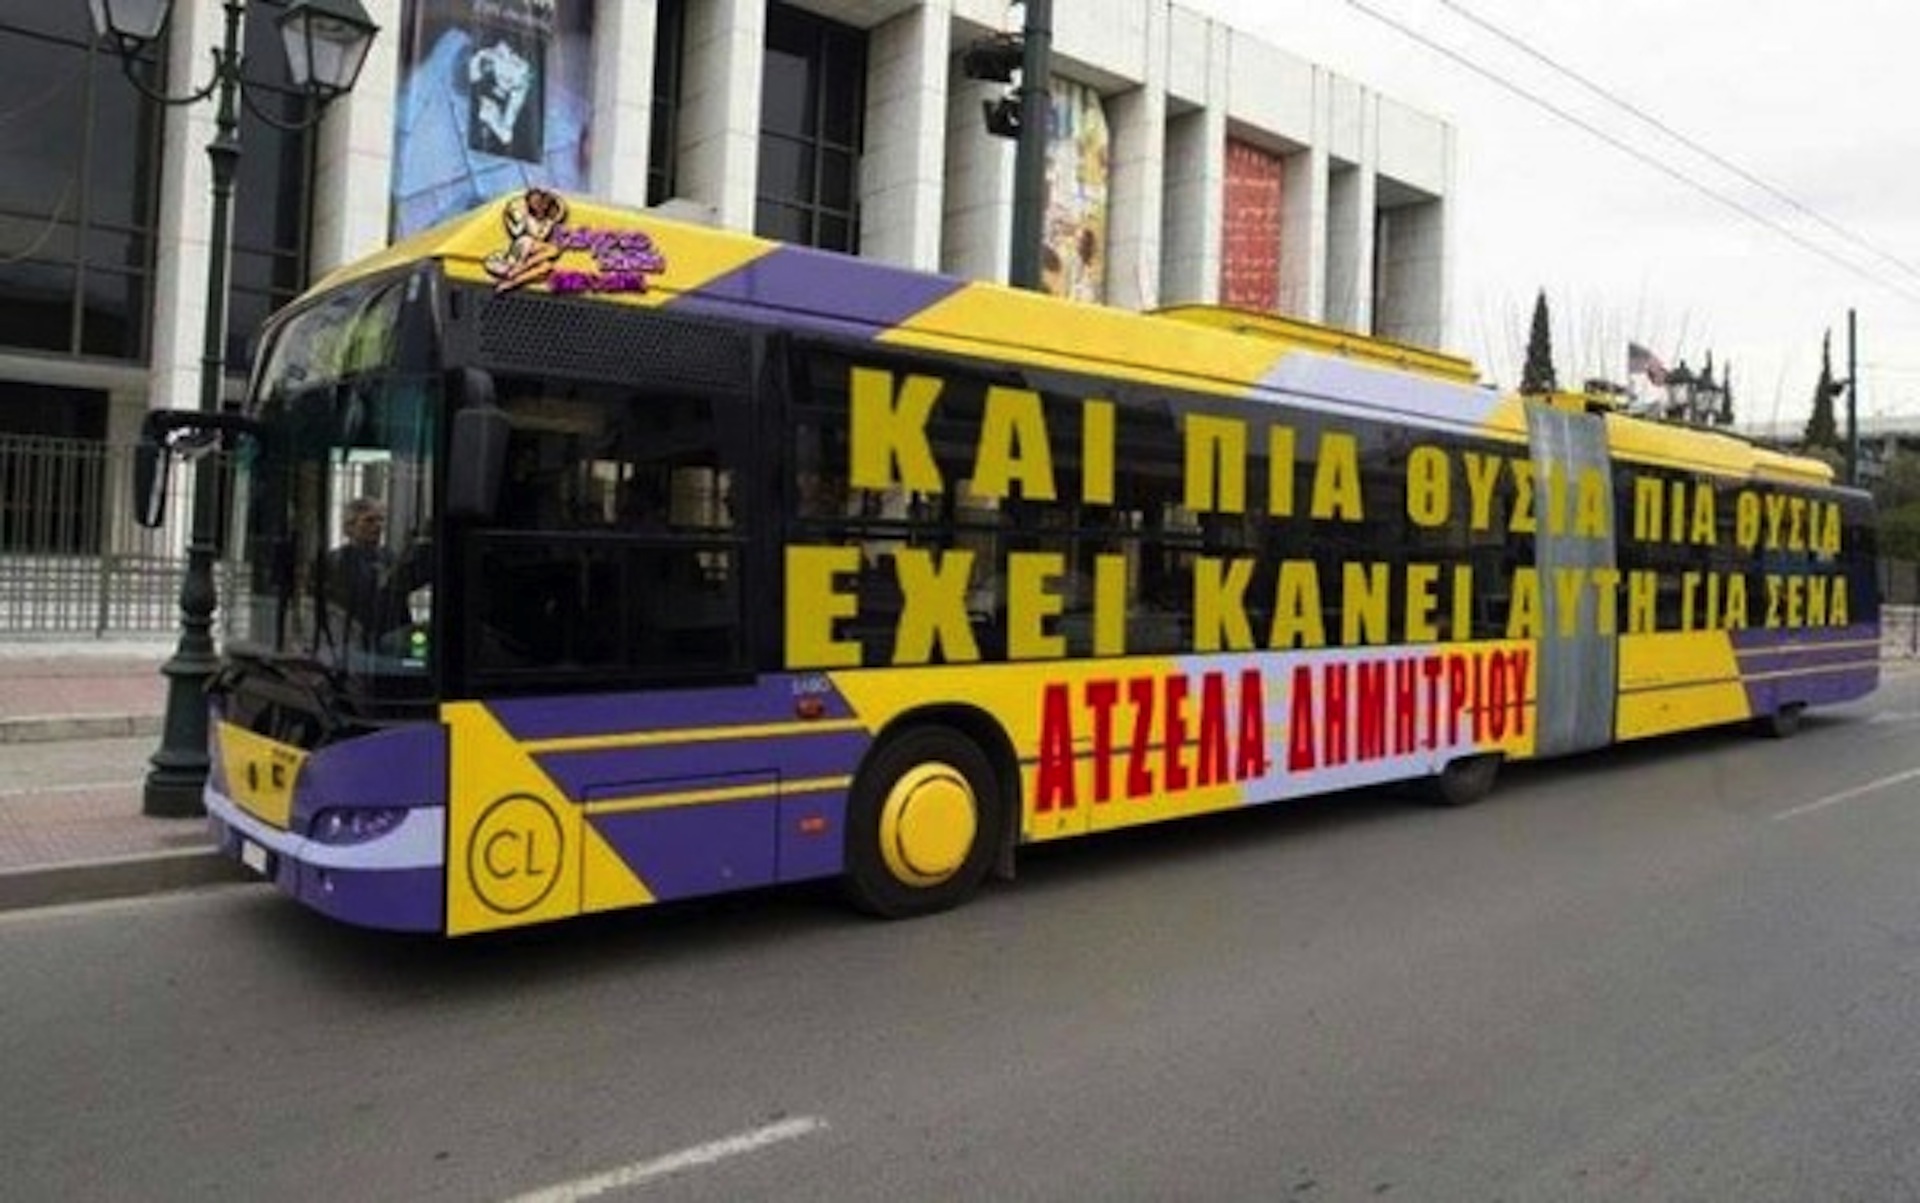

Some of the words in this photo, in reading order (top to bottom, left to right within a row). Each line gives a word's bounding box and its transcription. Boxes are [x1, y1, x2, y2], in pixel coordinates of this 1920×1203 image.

[850, 366, 1116, 504] ΚΑΙ
[1185, 414, 1364, 521] ΠΙΑ
[1406, 445, 1610, 538] ΘΥΣΙΑ
[1634, 475, 1717, 546] ΠΙΑ
[1736, 490, 1843, 556] ΘΥΣΙΑ
[784, 545, 1127, 670] ΕΧΕΙ
[1194, 558, 1474, 652] ΚΑΝΕΙ
[1506, 567, 1657, 640] ΑΥΤΗ
[1681, 571, 1748, 633] ΓΙΑ
[1765, 574, 1849, 629] ΣΕΝΑ
[1035, 669, 1266, 812] ΑΤΖΕΛΑ
[1287, 648, 1531, 773] ΔΗΜΗΤΡΙΟΥ
[483, 829, 545, 881] CL
